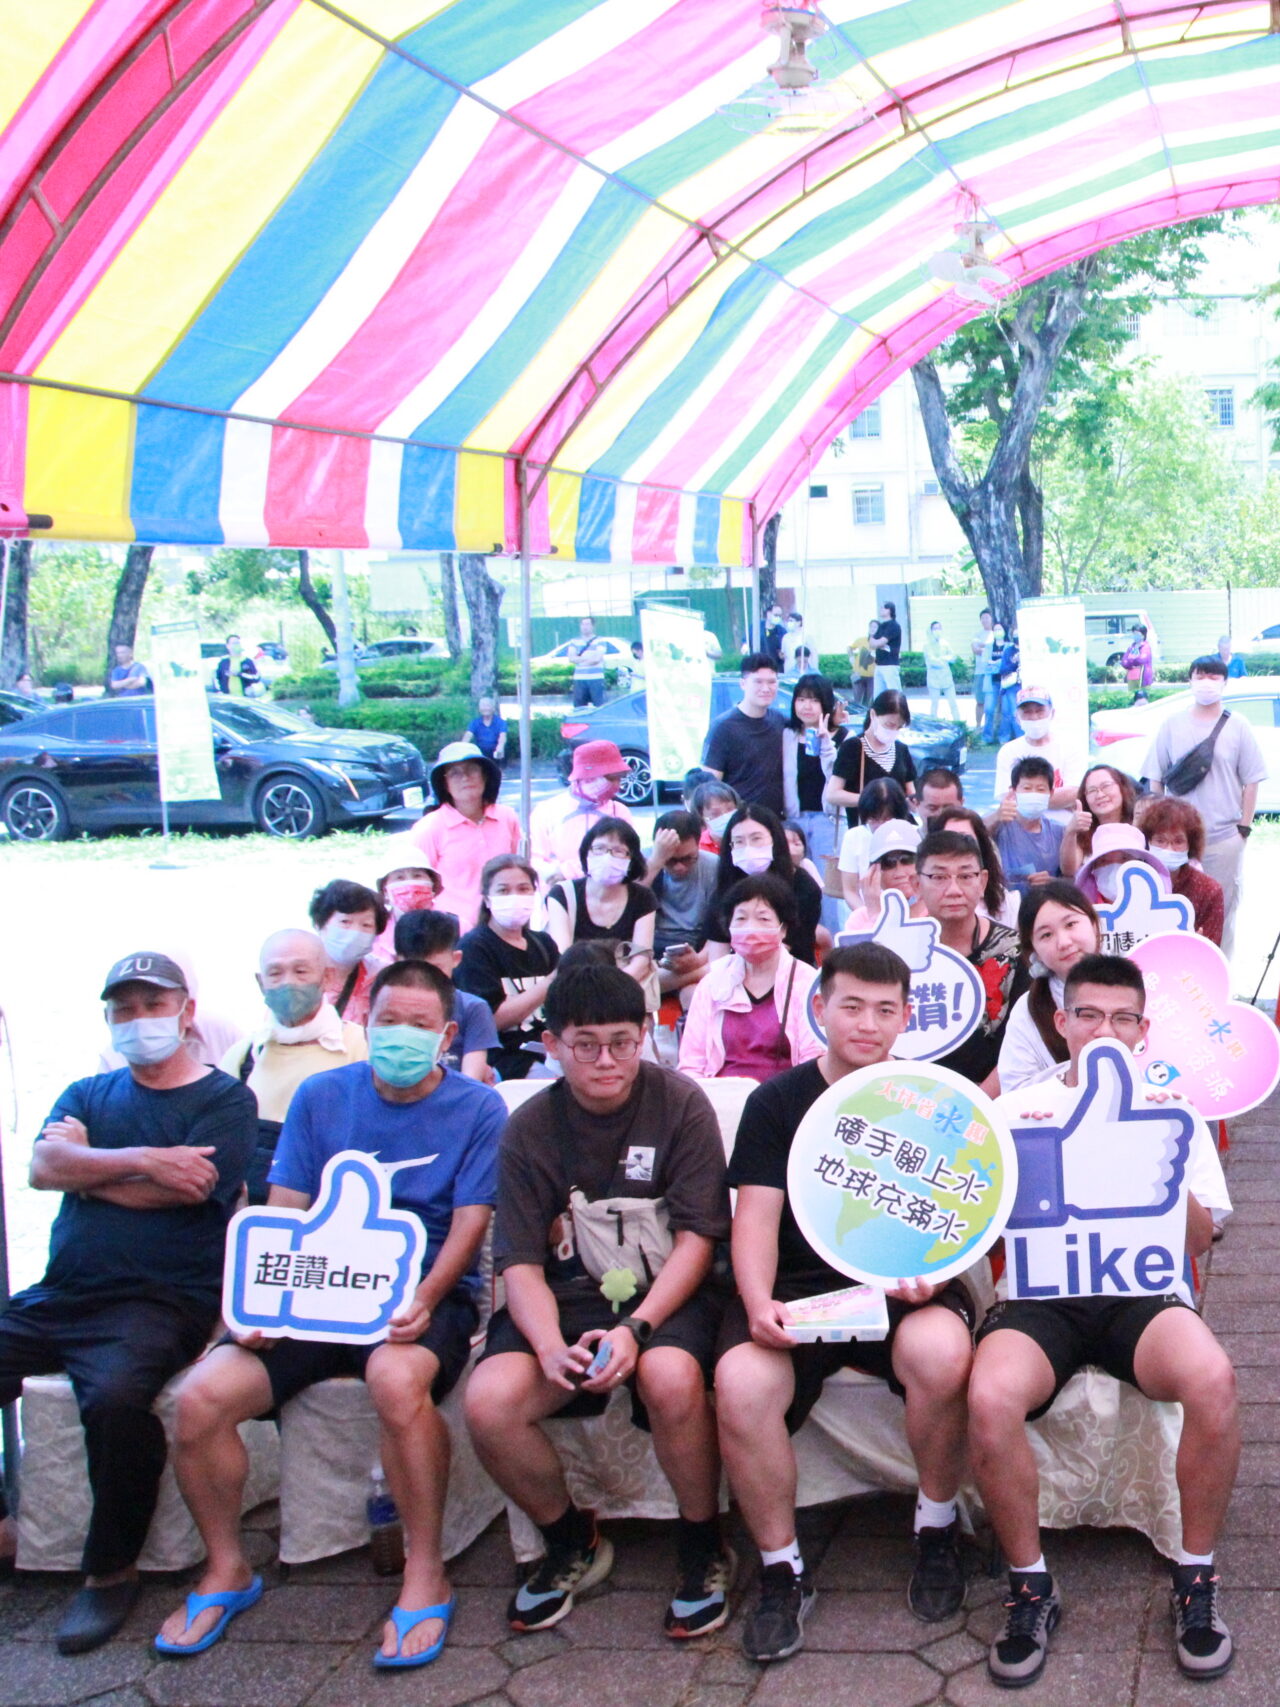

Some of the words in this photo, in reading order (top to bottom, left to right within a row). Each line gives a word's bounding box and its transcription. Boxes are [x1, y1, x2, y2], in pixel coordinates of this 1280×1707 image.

[813, 1153, 968, 1243] 地球充滿水
[834, 1116, 987, 1203] 隨手關上水
[254, 1251, 390, 1291] 超讚der
[1014, 1231, 1175, 1298] Like
